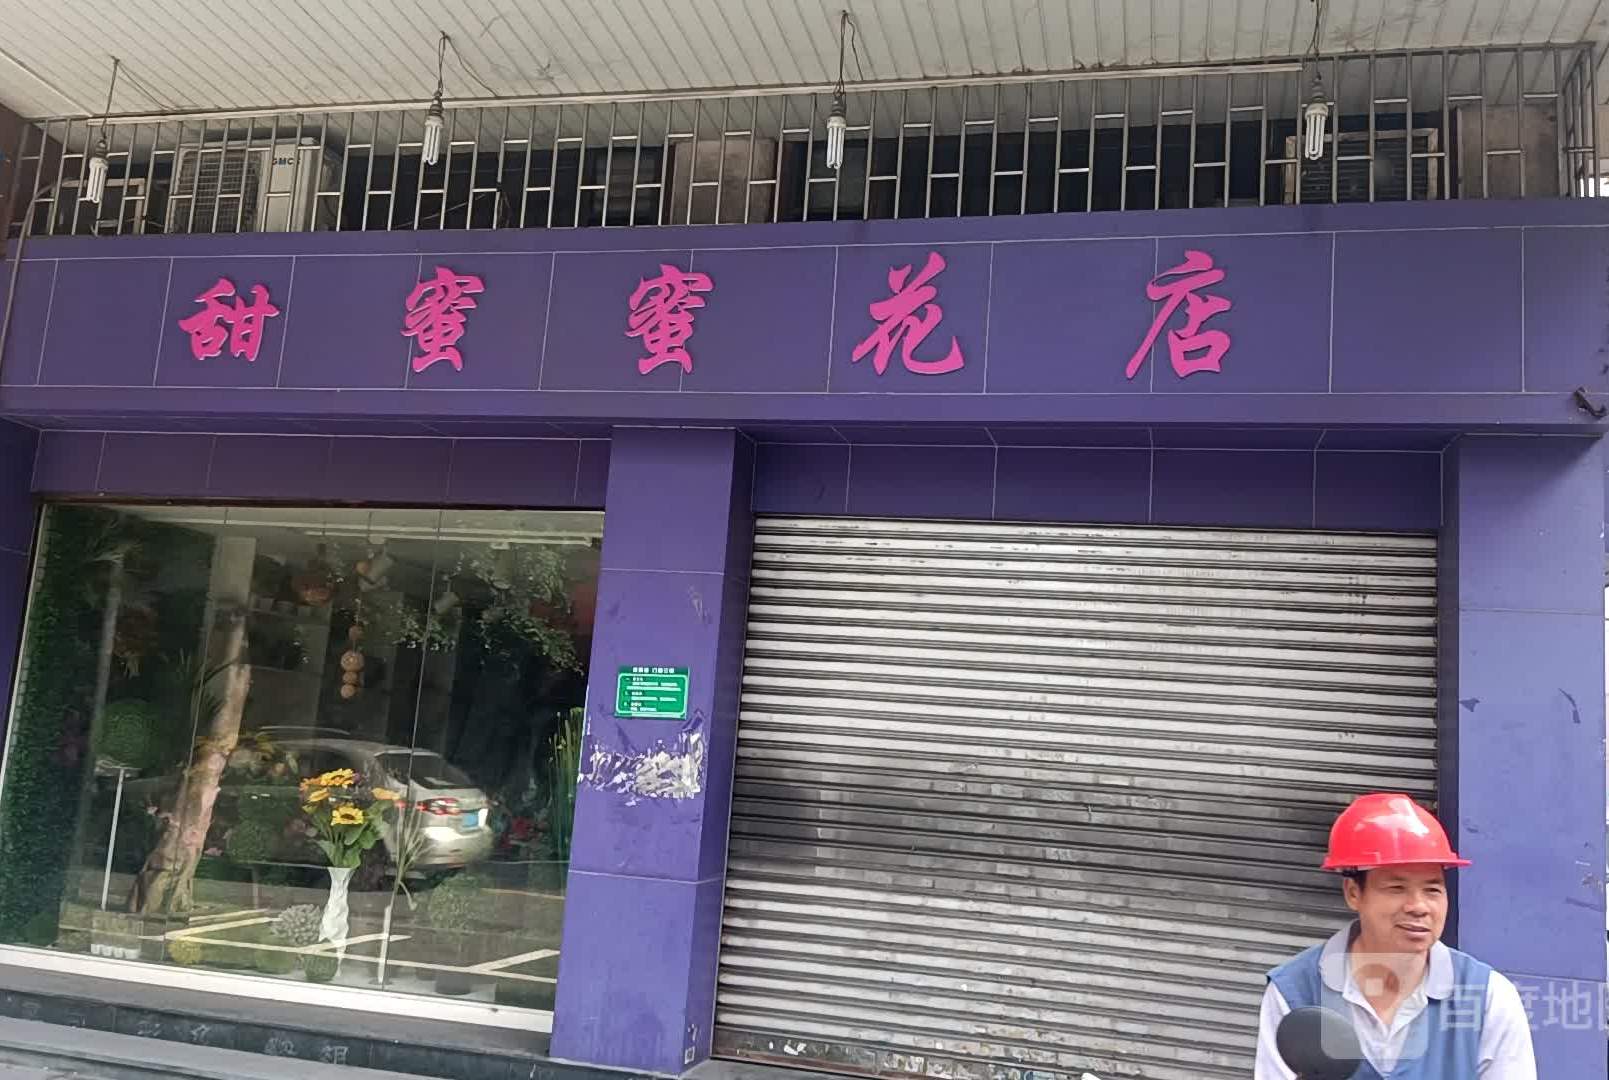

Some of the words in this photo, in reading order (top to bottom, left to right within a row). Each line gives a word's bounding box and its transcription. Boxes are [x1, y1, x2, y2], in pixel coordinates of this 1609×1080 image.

[179, 250, 1231, 378] 甜蜜蜜花店
